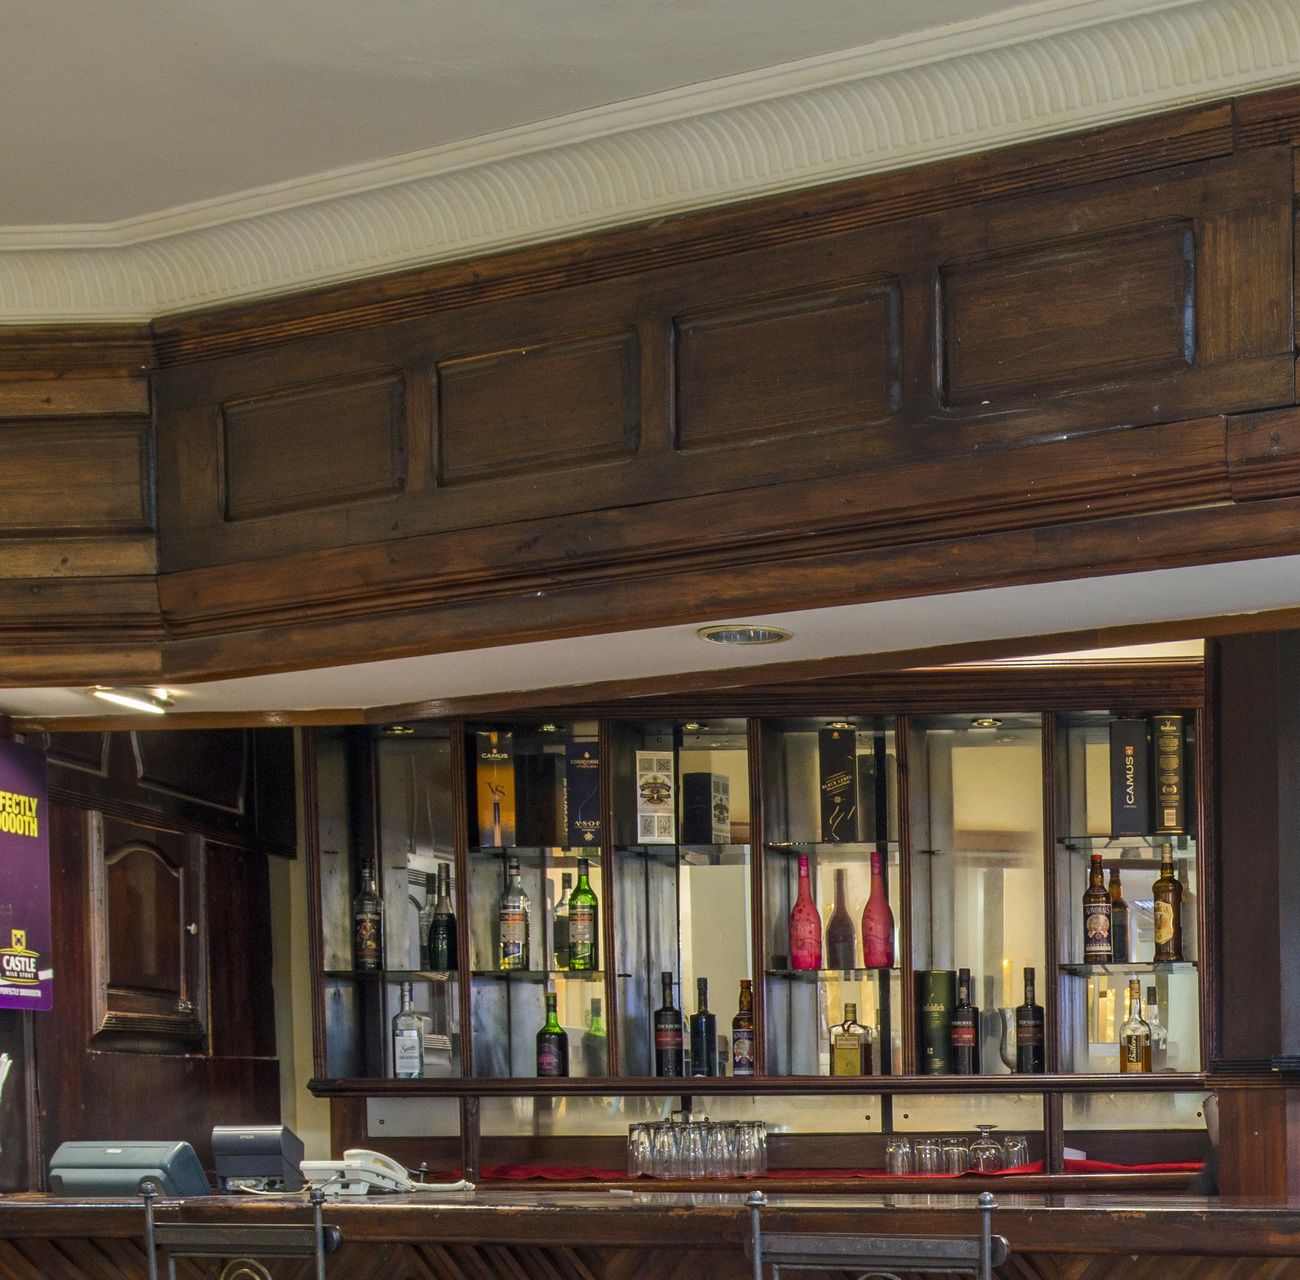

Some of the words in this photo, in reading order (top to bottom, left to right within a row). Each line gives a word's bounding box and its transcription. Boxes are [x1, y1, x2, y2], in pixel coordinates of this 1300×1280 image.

[1125, 756, 1134, 804] CAMUS
[0, 811, 38, 837] OOOTH
[3, 955, 37, 973] CASTLE
